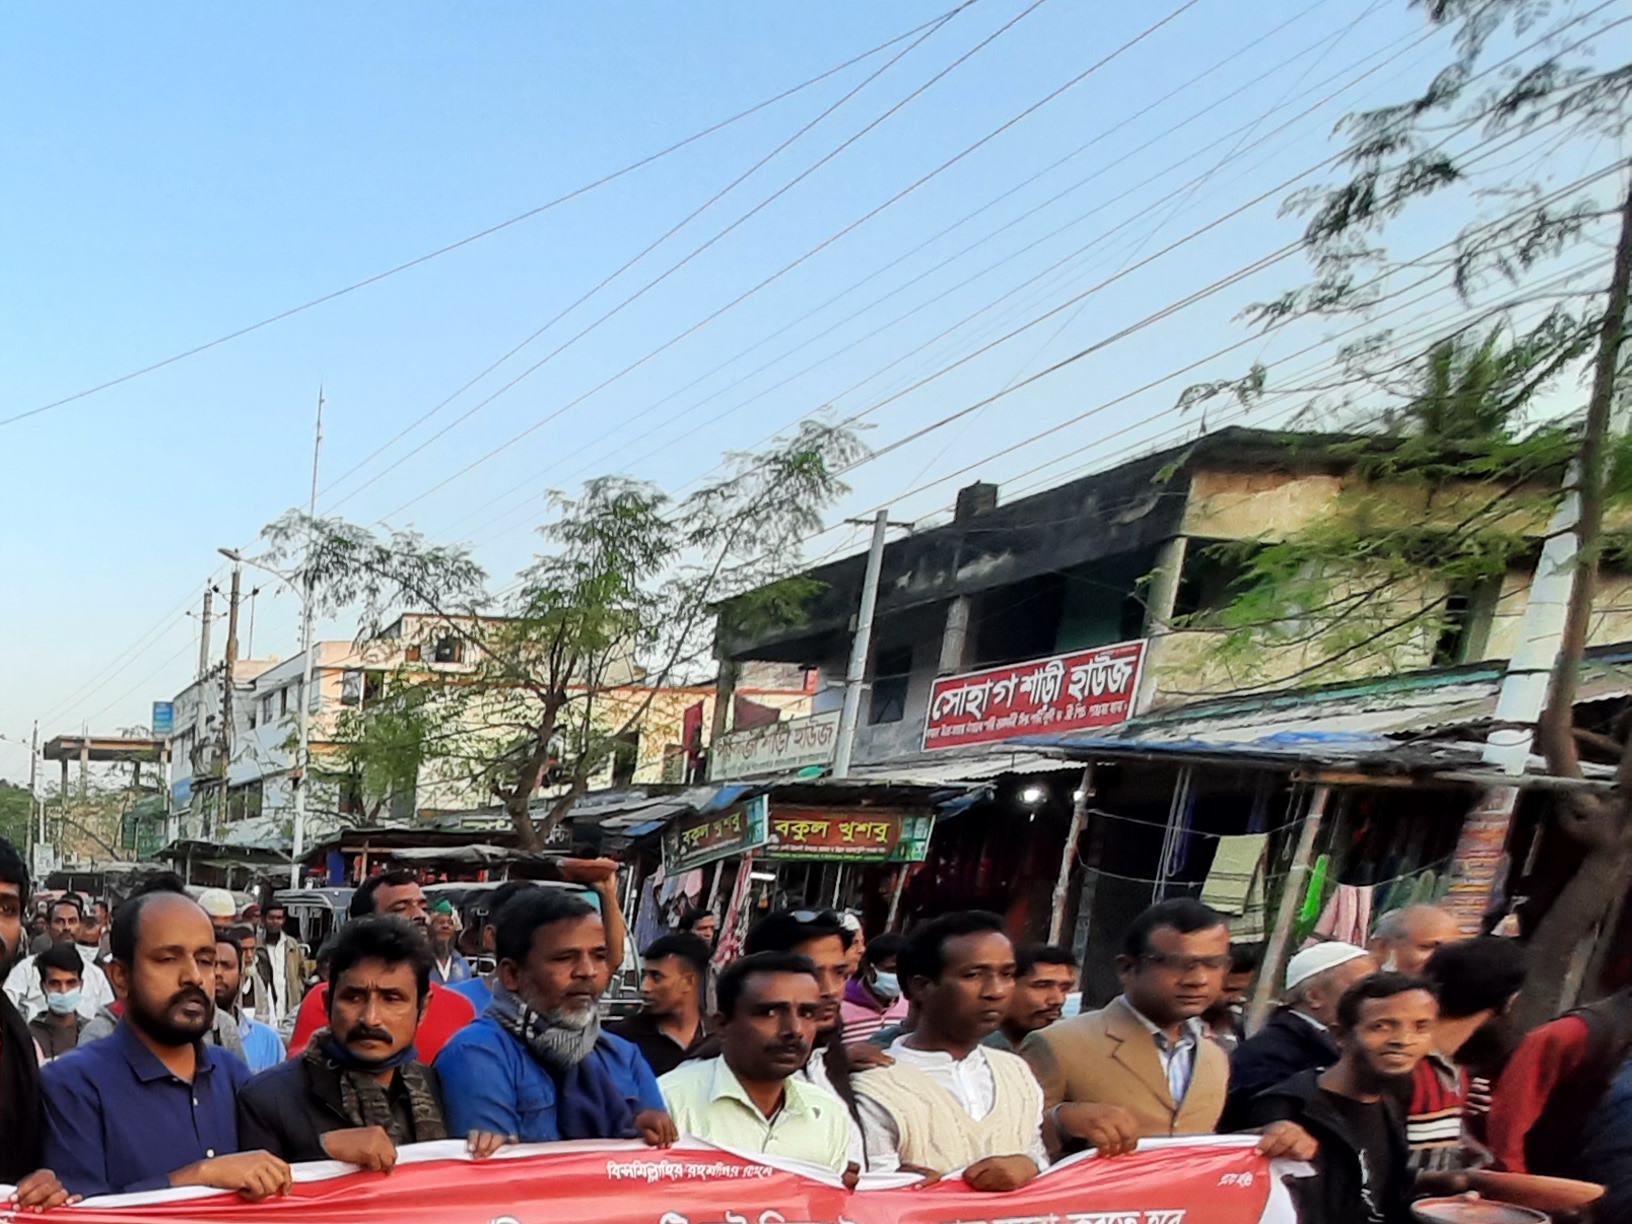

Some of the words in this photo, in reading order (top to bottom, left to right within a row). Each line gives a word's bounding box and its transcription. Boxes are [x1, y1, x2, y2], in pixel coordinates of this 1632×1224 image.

[931, 672, 1019, 721] সোহাগ
[1020, 659, 1066, 710] শাড়ী
[1068, 653, 1138, 702] হাউজ
[773, 819, 831, 843] বকুল
[838, 820, 890, 844] খুশবু
